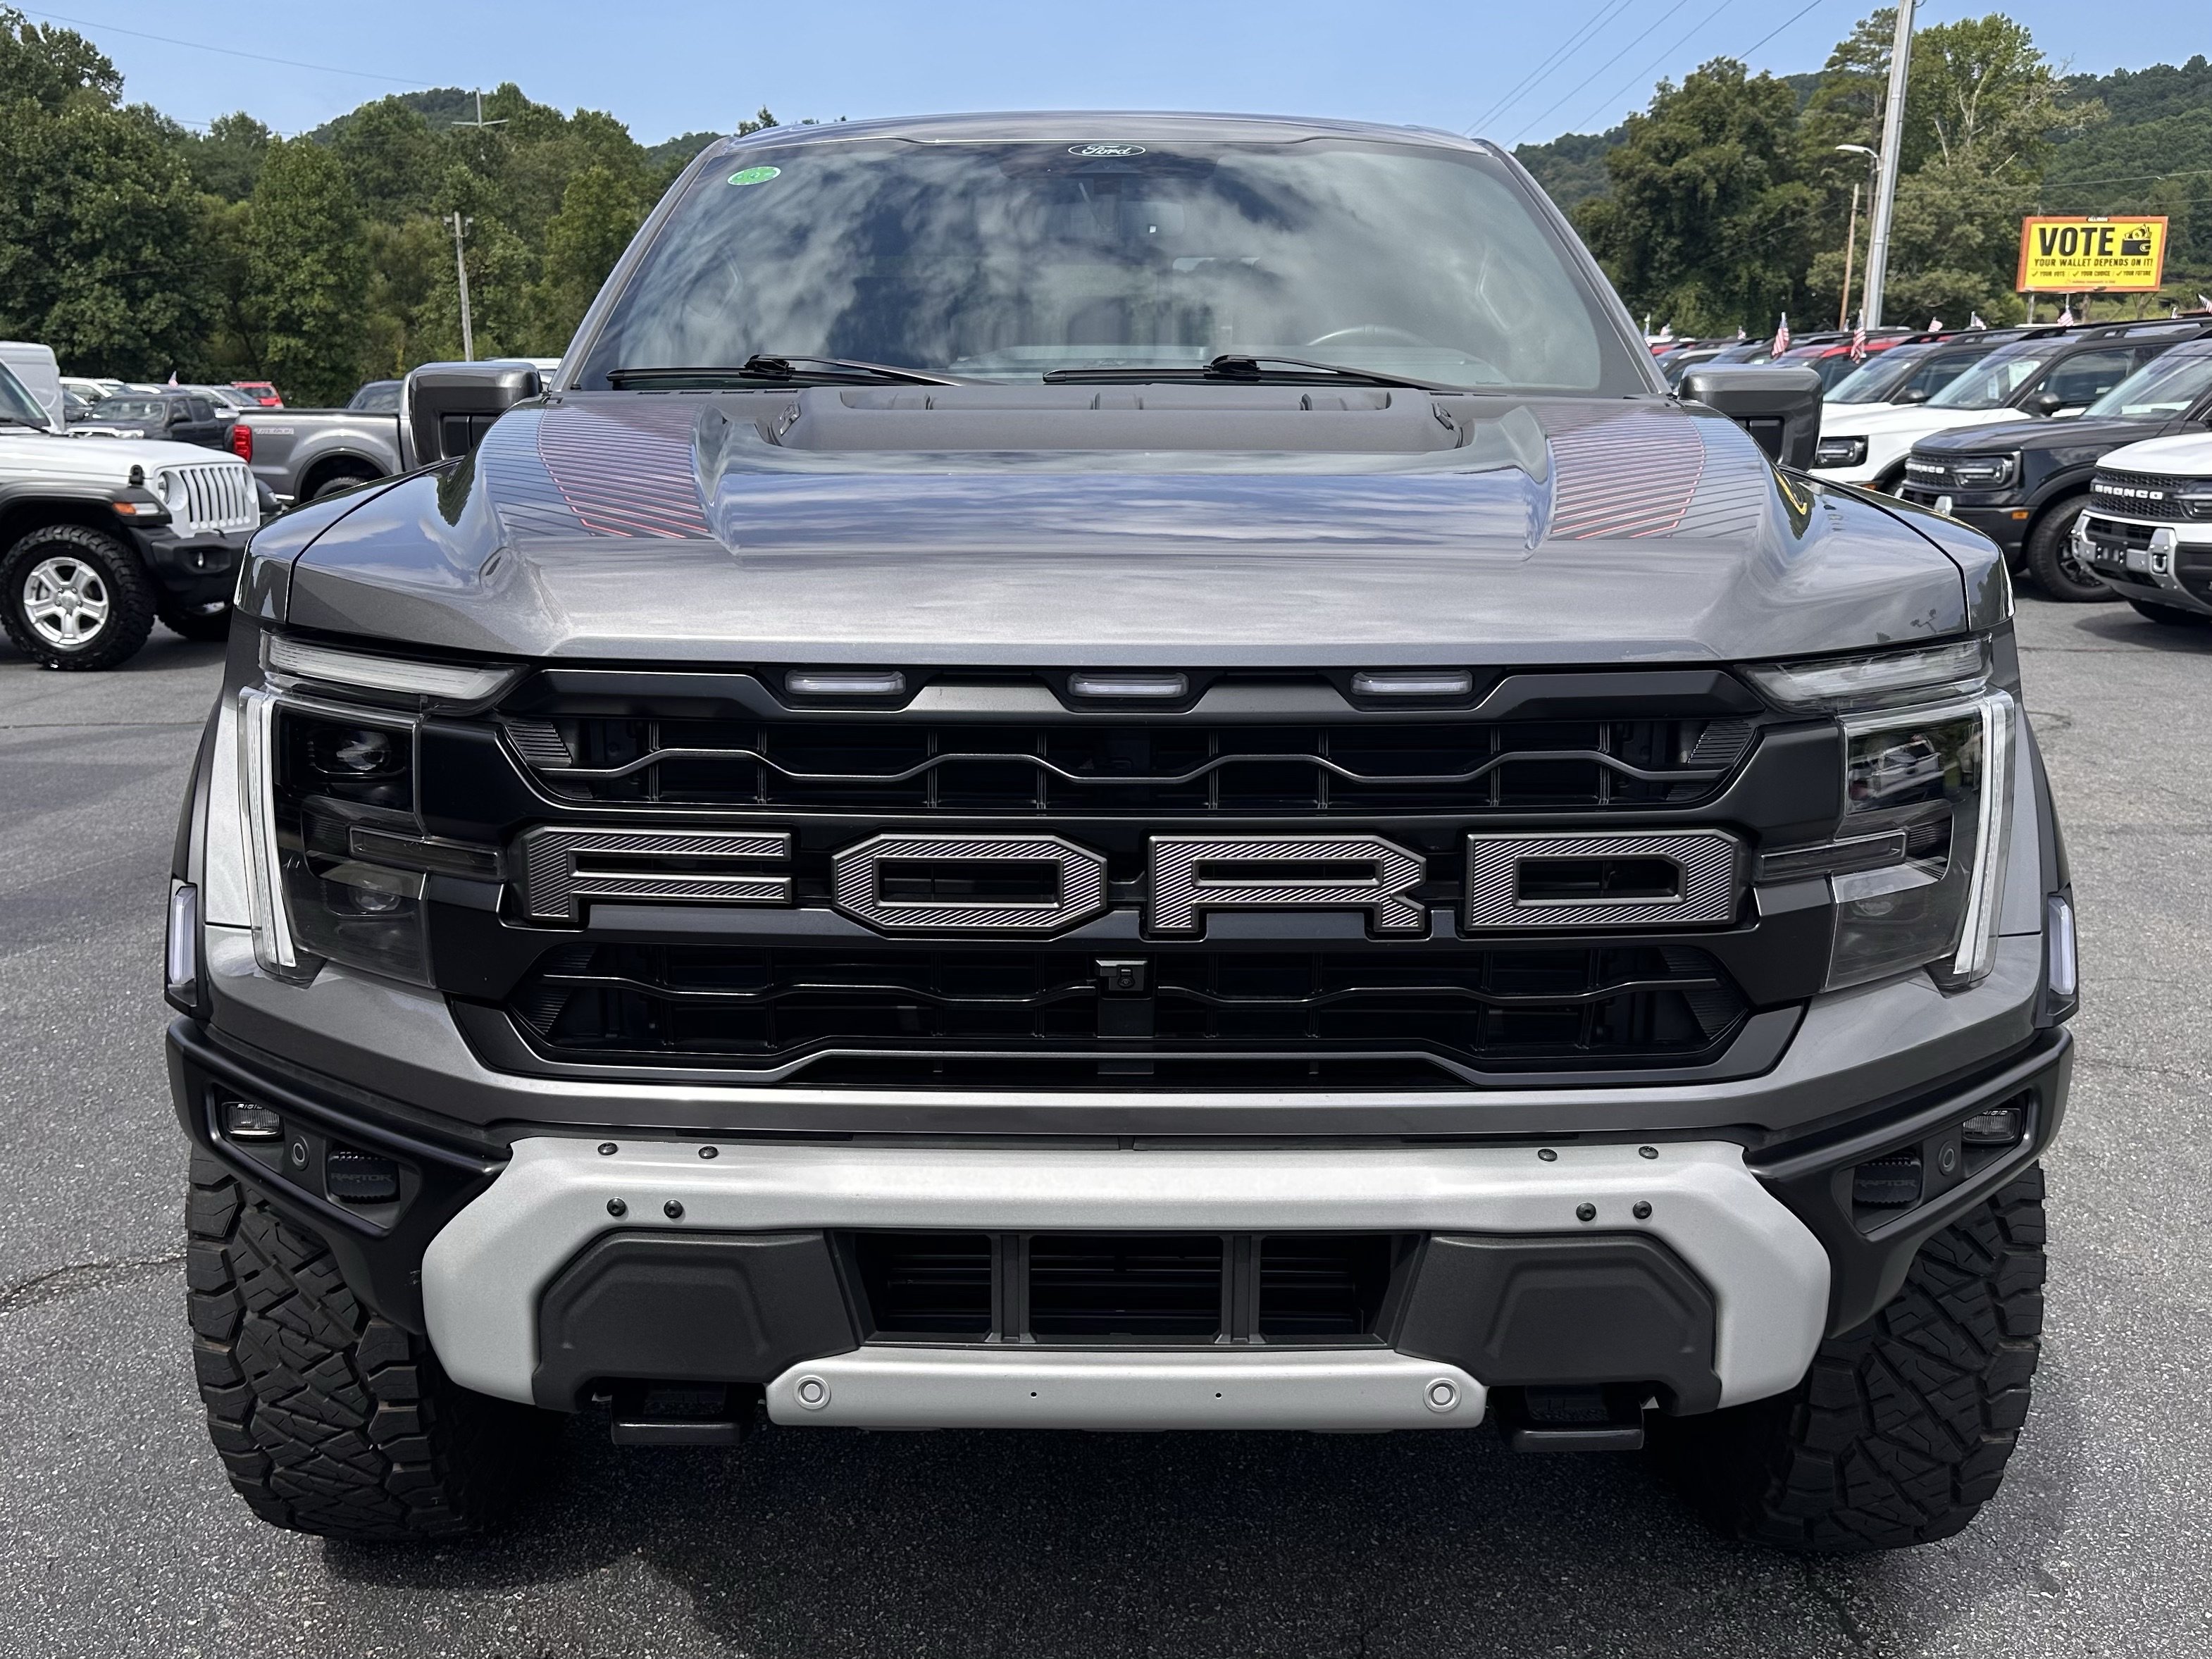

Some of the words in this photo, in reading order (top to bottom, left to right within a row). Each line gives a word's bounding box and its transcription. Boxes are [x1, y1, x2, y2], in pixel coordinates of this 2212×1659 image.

[1081, 144, 1133, 155] Ford
[2039, 227, 2115, 256] VOTE
[2034, 259, 2056, 267] YOUR
[2059, 258, 2092, 267] WALLET
[2094, 258, 2129, 267] DEPENDS
[2131, 258, 2142, 267] ON
[2094, 484, 2163, 500] BRONCO
[518, 824, 1739, 934] FORD
[330, 1172, 394, 1183] RAPTOR
[1854, 1179, 1918, 1188] RAPTOR
